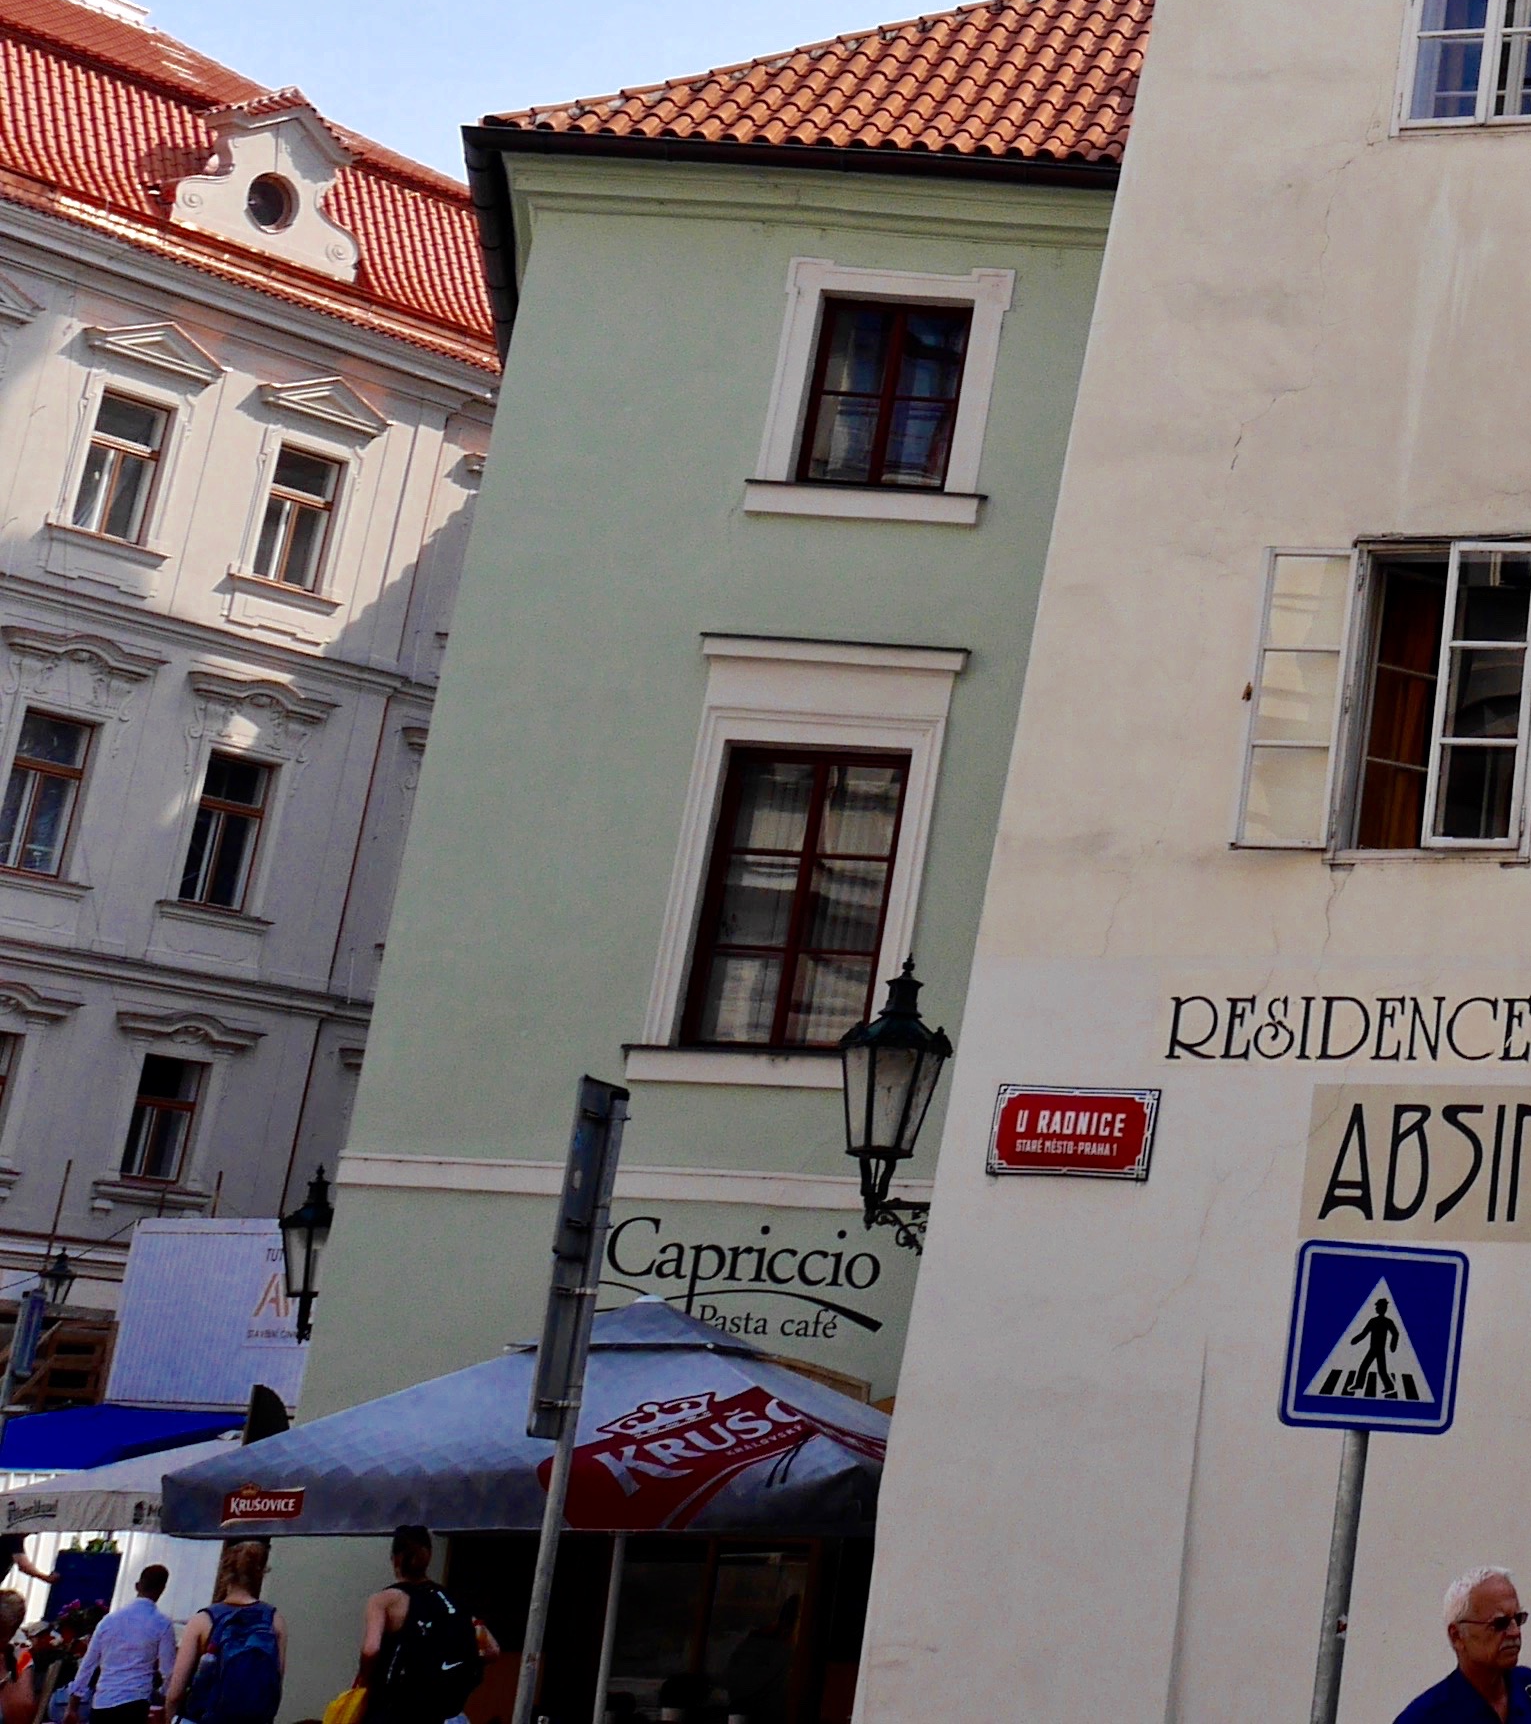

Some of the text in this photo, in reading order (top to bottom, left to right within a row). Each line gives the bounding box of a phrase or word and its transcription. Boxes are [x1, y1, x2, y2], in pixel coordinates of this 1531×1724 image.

[1015, 1109, 1127, 1138] U RADNICE
[1015, 1137, 1043, 1154] STARÉ
[1112, 1142, 1118, 1157] 1
[606, 1216, 881, 1315] Capriccio
[699, 1303, 839, 1339] Pasta café
[229, 1495, 297, 1516] KRUŠOVICE
